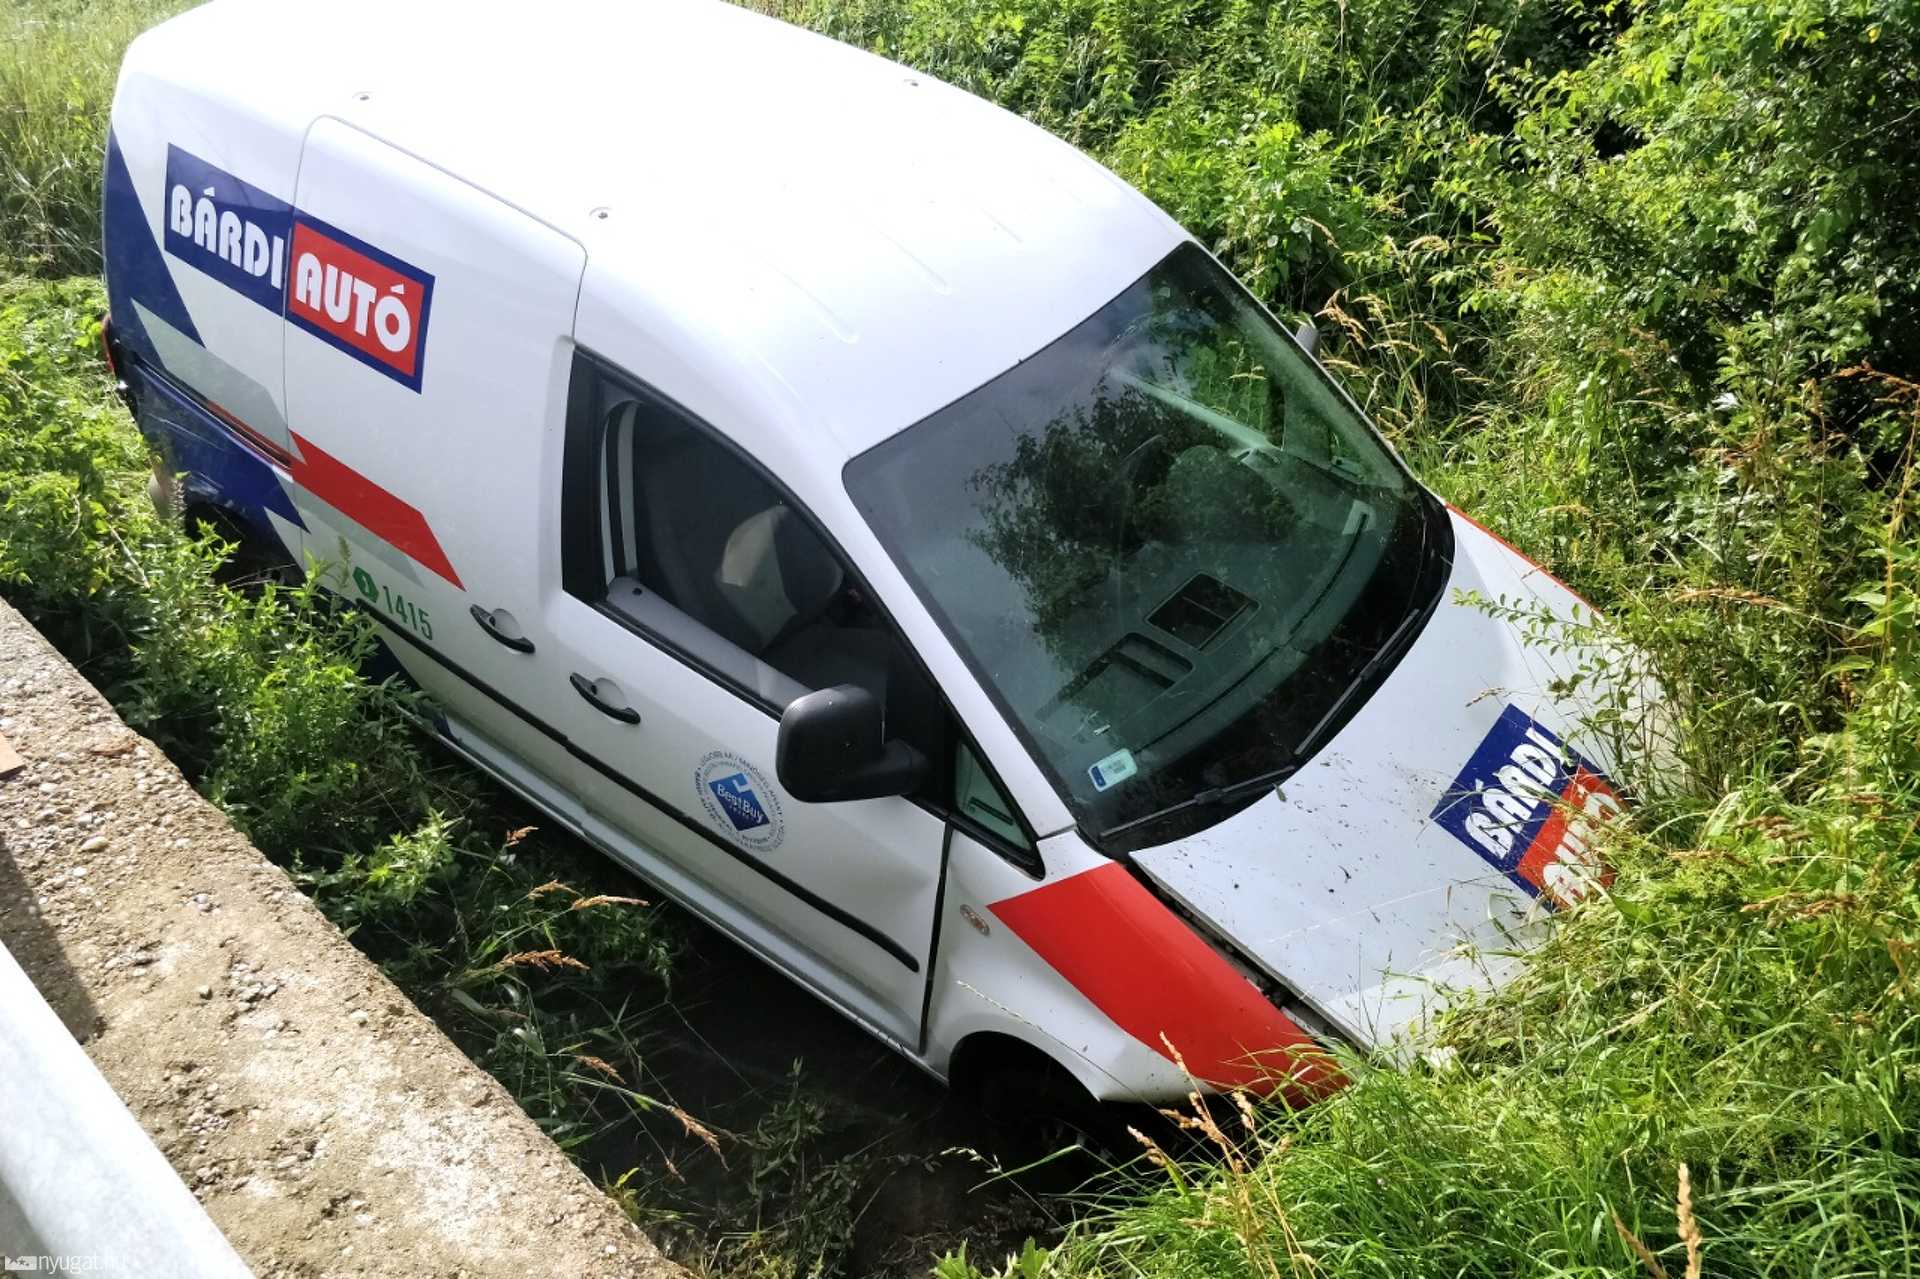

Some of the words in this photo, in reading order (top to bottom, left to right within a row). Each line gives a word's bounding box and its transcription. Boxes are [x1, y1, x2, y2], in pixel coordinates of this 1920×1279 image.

[171, 184, 284, 290] BÁRDI
[296, 252, 411, 352] AUTÓ
[382, 585, 433, 640] 1415
[1465, 727, 1570, 860] BÁRDI
